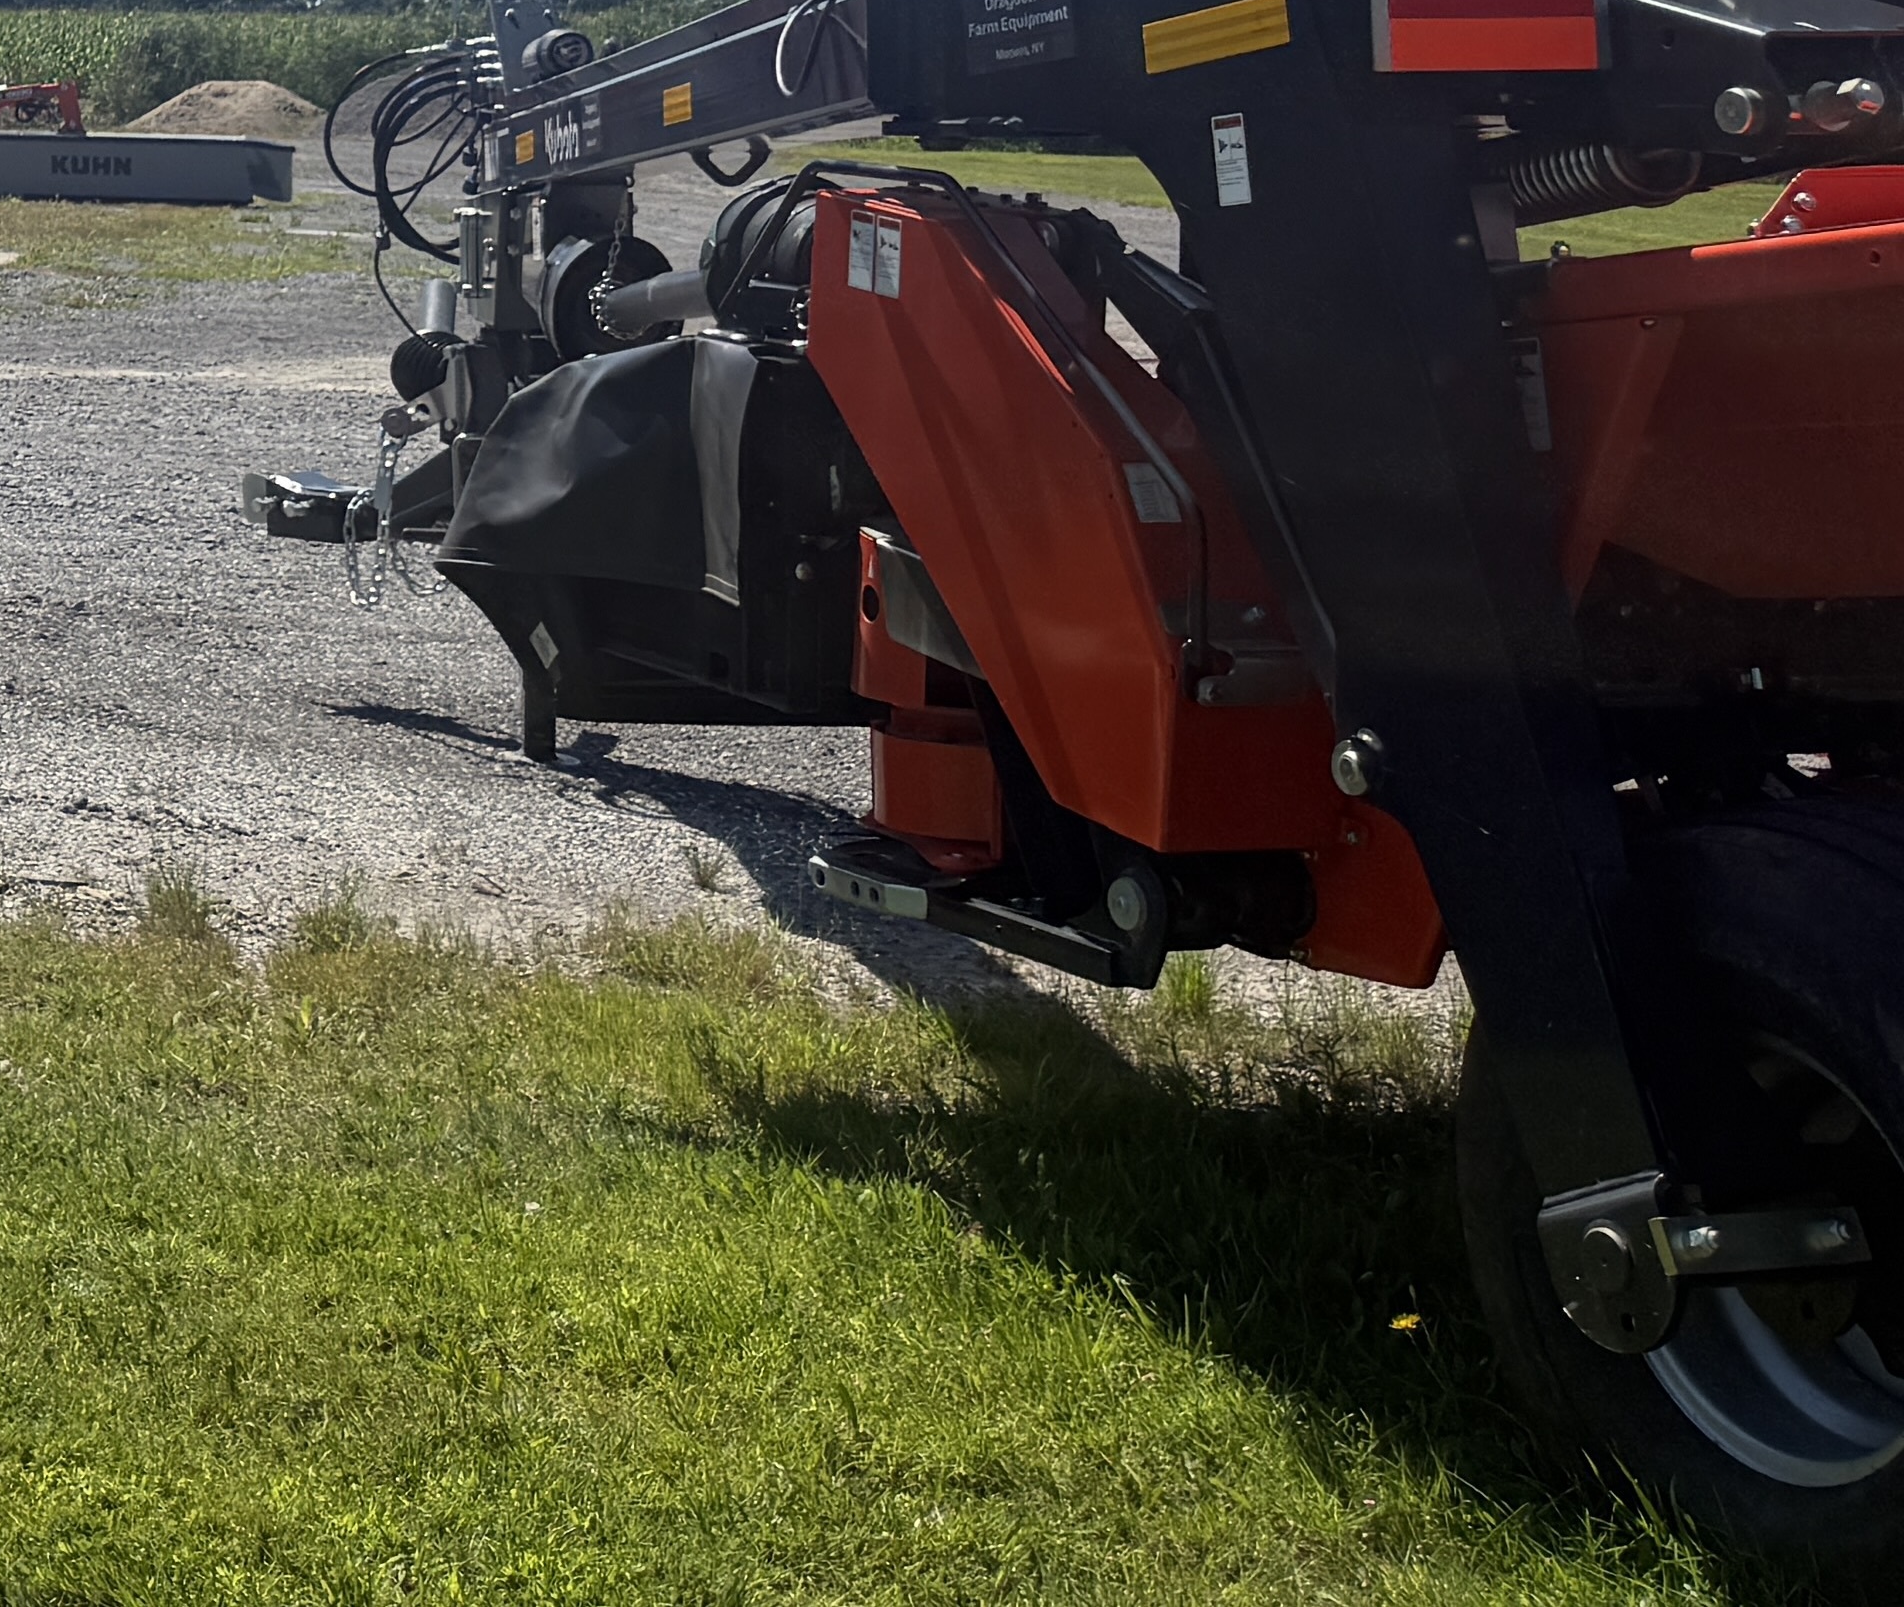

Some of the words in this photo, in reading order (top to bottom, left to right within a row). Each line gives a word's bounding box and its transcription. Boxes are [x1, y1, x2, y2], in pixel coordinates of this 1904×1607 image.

[968, 21, 1000, 38] Farm
[1000, 6, 1068, 33] Equipment
[51, 155, 132, 176] KUHN
